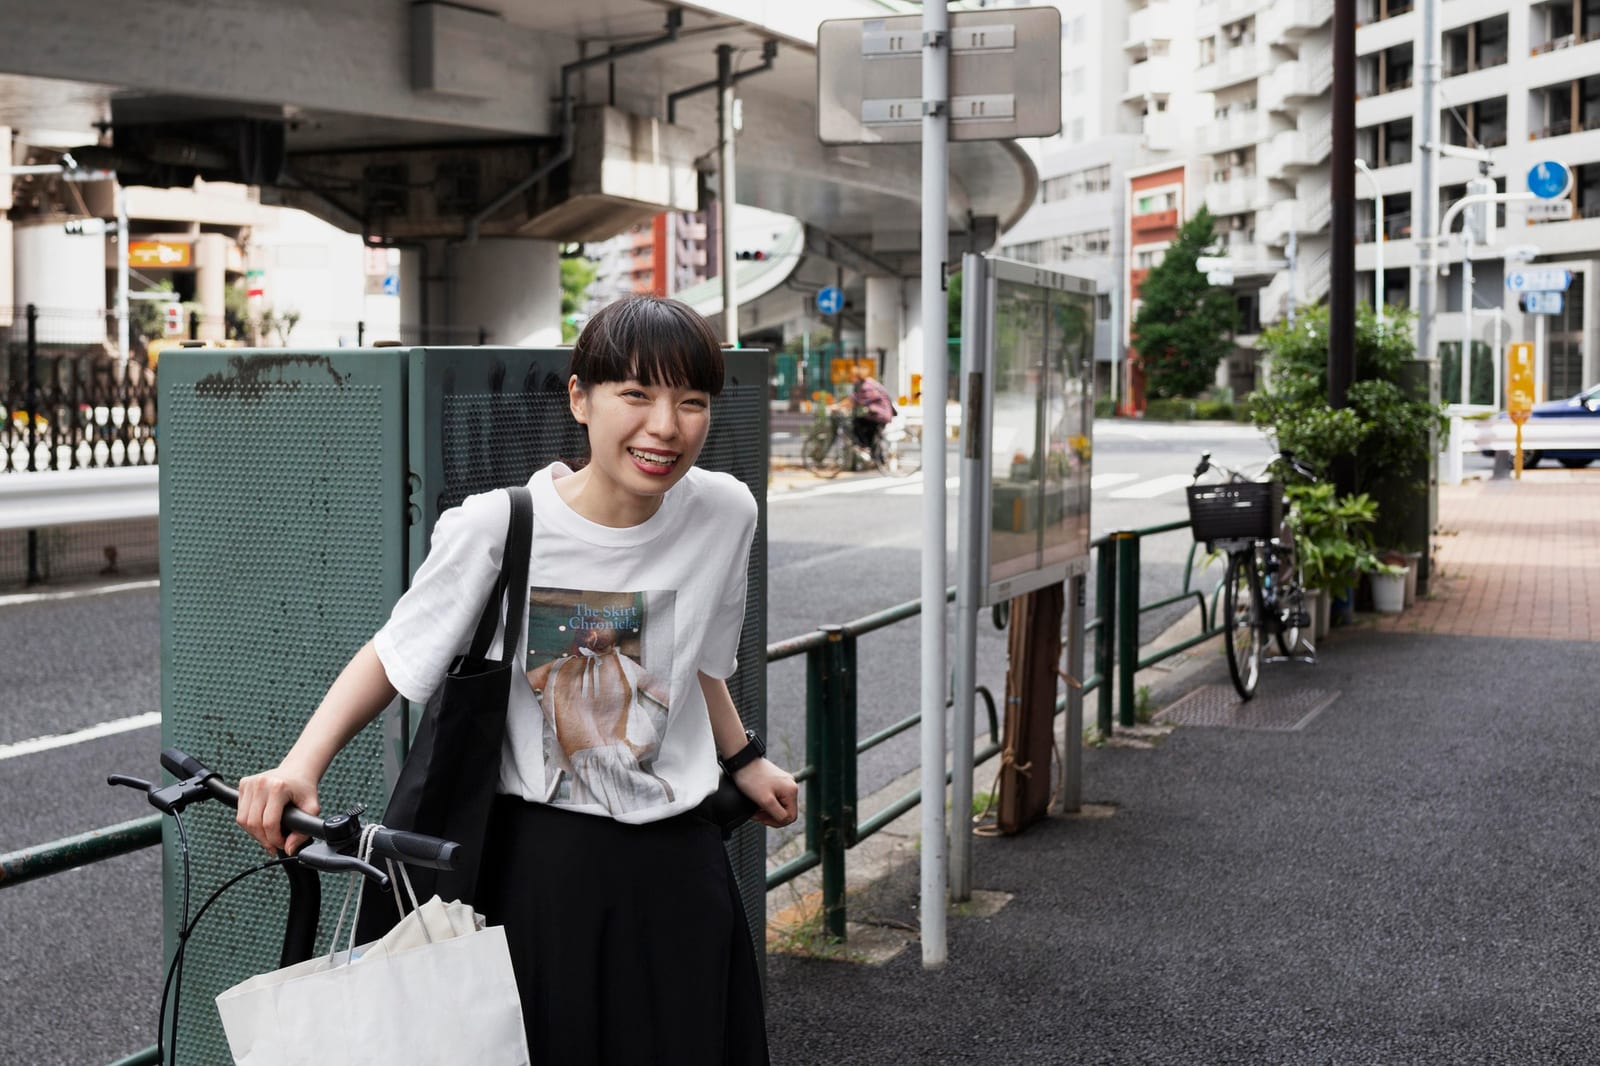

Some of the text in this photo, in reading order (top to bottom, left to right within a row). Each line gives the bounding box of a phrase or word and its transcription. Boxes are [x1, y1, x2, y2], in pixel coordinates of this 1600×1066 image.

[575, 603, 637, 617] The Skirt
[569, 616, 641, 630] Chronicles
